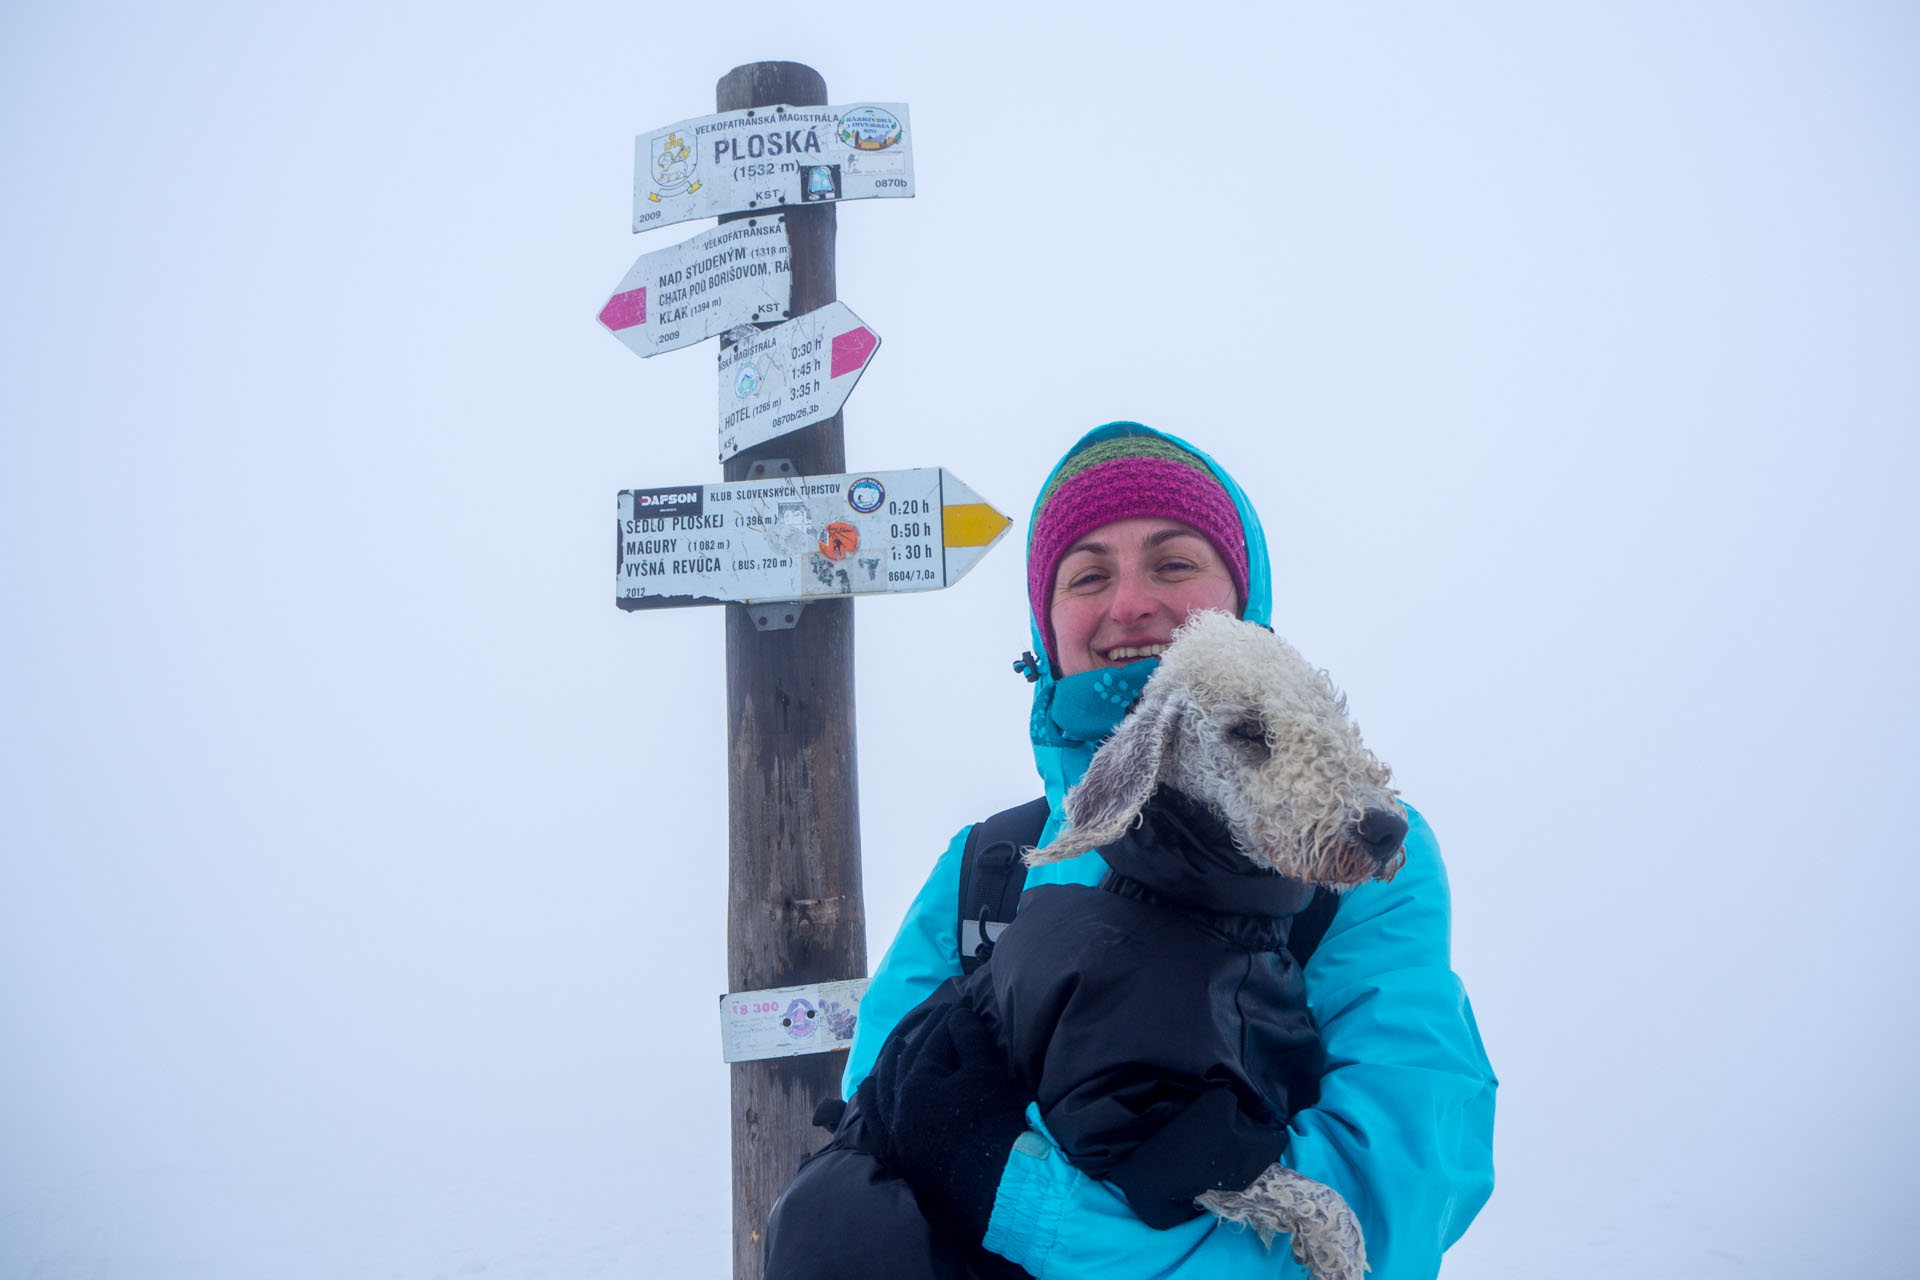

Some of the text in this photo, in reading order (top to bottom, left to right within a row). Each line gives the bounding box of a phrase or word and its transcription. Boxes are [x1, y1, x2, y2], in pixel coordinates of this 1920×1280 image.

[779, 113, 840, 122] MAGISTRÁLA
[714, 125, 822, 164] PLOSKÁ
[733, 159, 801, 181] (1532 m)
[875, 178, 908, 188] 0870b
[755, 189, 779, 200] KST
[640, 211, 662, 222] 2009
[659, 271, 682, 288] NAD
[685, 247, 746, 279] STUDENÝM
[751, 247, 776, 259] (1318
[659, 288, 688, 306] CHATA
[689, 279, 706, 295] POD
[708, 263, 770, 288] BORIŠOVOM,
[690, 303, 710, 317] (1394
[711, 297, 722, 308] m)
[758, 303, 780, 313] KST
[659, 330, 680, 344] 2009
[734, 338, 777, 360] MAGISTRÁLA
[791, 338, 822, 360] 0:30 h
[792, 359, 821, 380] 1:45 h
[790, 379, 820, 401] 3:35 h
[725, 406, 751, 430] HOTEL
[752, 401, 771, 418] (1265
[772, 397, 782, 409] m)
[772, 403, 819, 428] 0870b/26,3b
[723, 436, 736, 450] KST
[640, 492, 697, 507] DAFSON
[710, 491, 732, 502] KLUB
[736, 486, 796, 501] SLOVENSKÝCH
[800, 483, 841, 495] TURISTOV
[889, 500, 919, 516] 0:20
[922, 500, 929, 513] h
[626, 518, 665, 534] SEDLO
[672, 514, 724, 531] PLOSKEJ
[890, 523, 931, 539] 0:50 h
[626, 538, 678, 556] MAGURY
[925, 544, 932, 558] h
[626, 559, 666, 578] VYŠNÁ
[672, 556, 722, 575] REVÚCA
[762, 558, 778, 570] 720
[626, 588, 646, 598] 2012
[753, 1001, 780, 1013] 300
